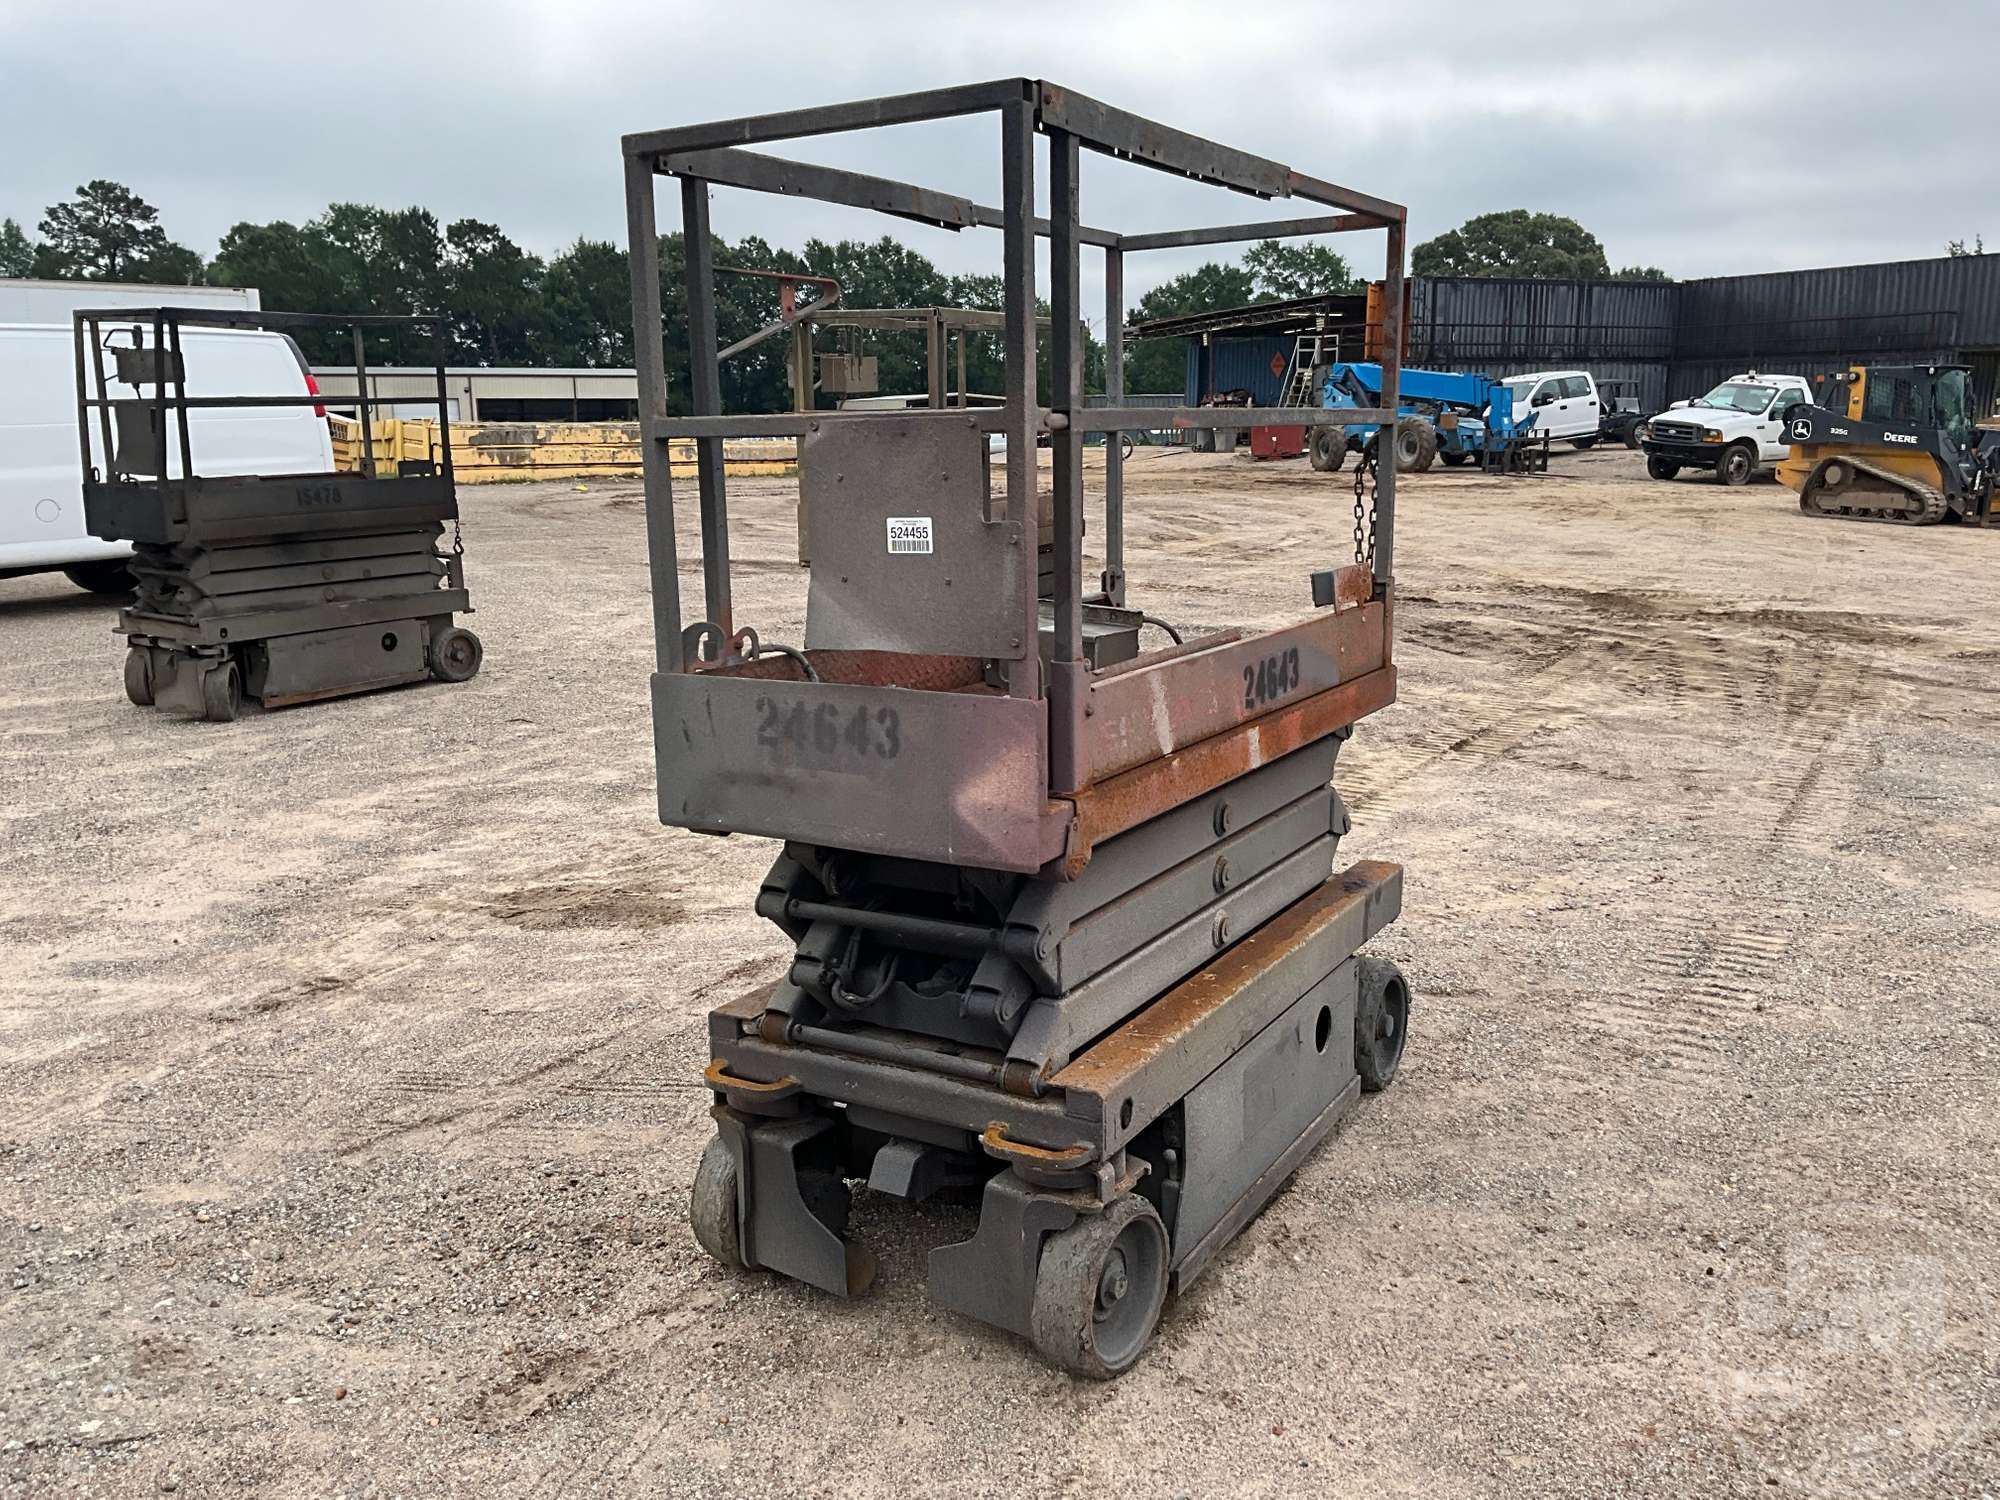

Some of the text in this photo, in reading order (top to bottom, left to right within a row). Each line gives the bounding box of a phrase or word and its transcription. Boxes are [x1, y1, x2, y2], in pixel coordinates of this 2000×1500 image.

[1883, 431, 1918, 444] DEERE
[890, 526, 929, 539] 524455
[1243, 647, 1300, 710] 24643
[756, 696, 901, 760] 24643
